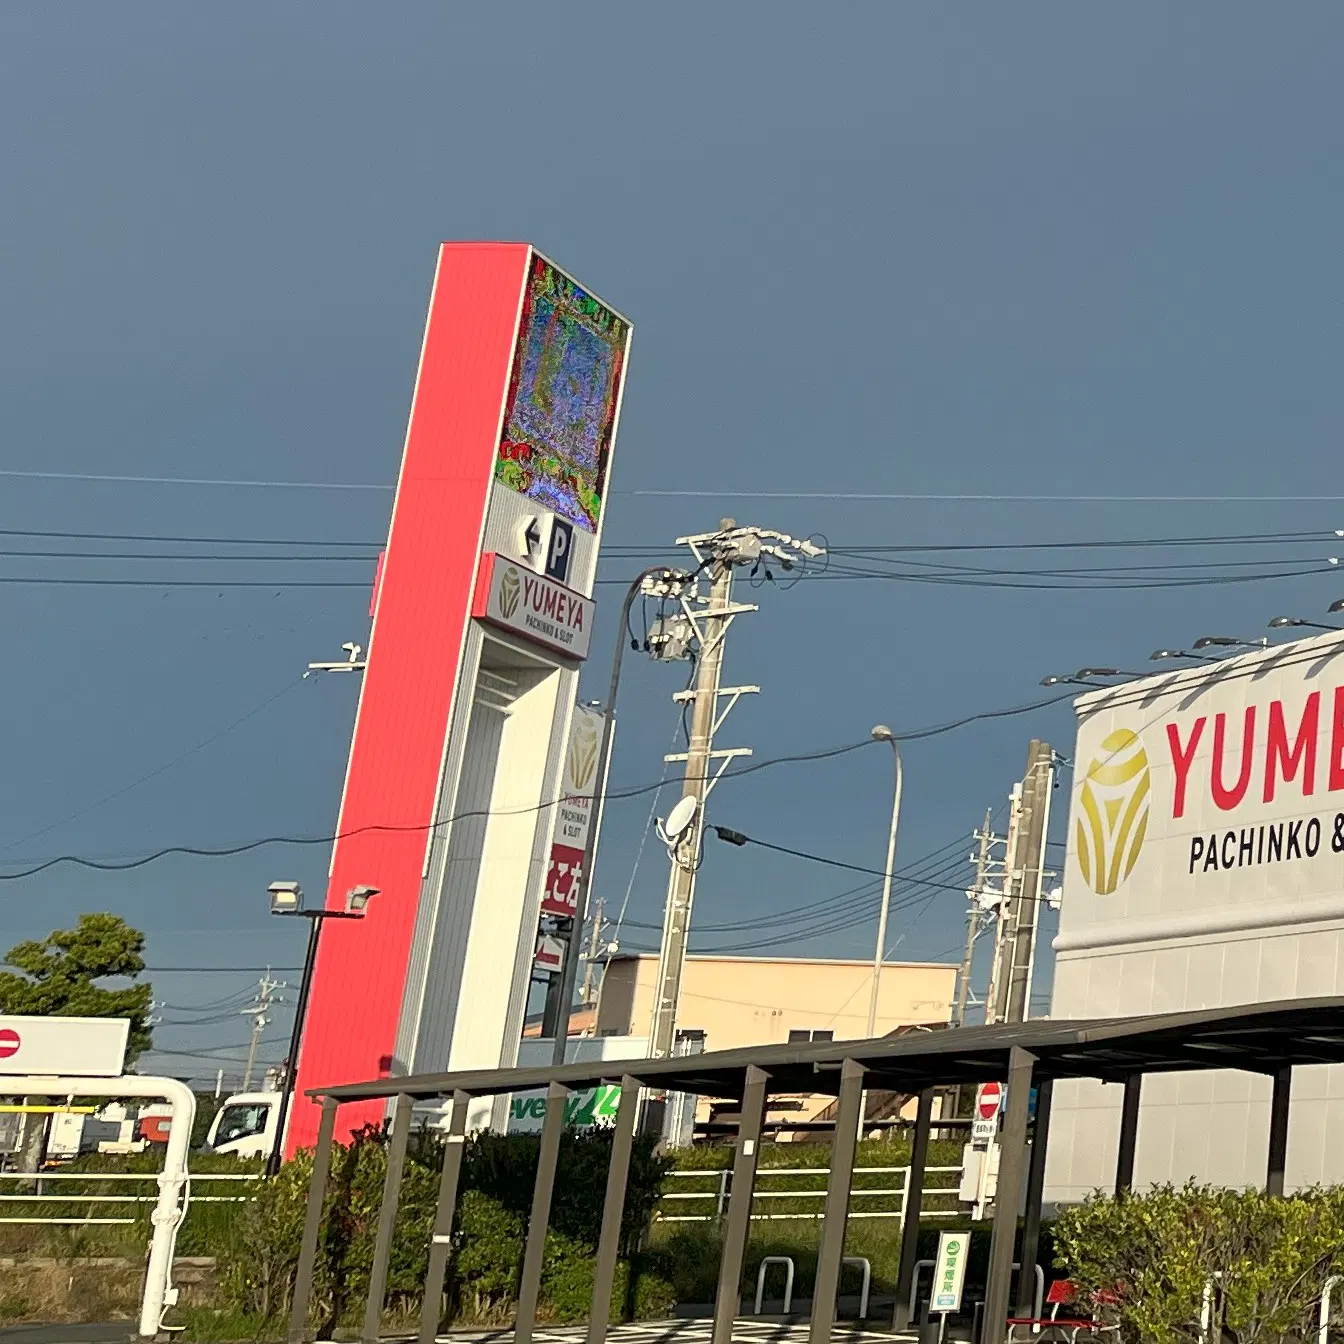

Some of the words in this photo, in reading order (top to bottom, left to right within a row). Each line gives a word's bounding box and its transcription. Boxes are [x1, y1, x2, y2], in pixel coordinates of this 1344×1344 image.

[550, 526, 567, 569] P
[523, 576, 583, 633] YUMEYA
[1189, 817, 1321, 874] PACHINKO
